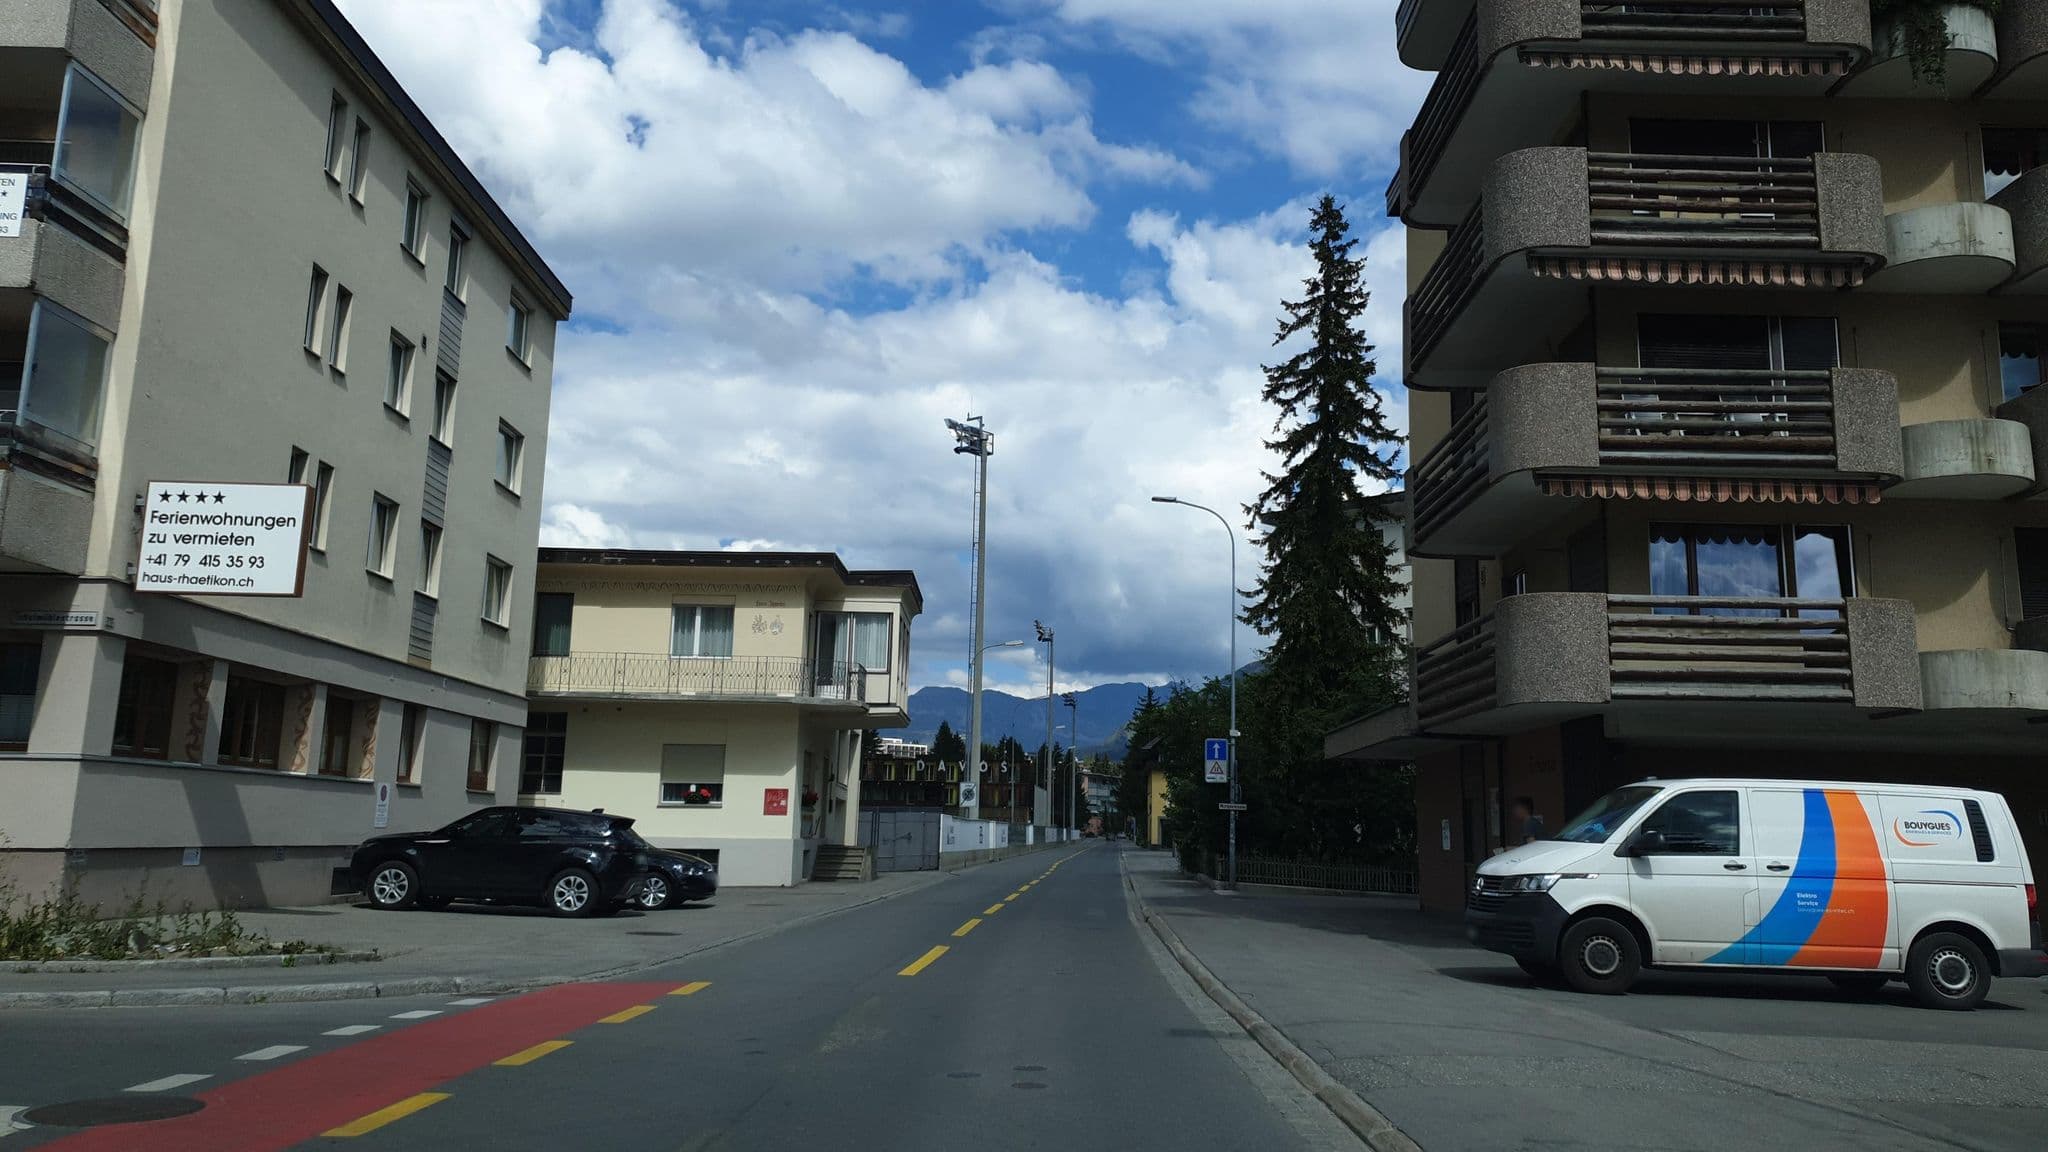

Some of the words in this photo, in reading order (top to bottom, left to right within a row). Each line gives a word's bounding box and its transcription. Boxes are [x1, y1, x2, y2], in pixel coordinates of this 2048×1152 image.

[150, 510, 296, 531] Ferienwohnungen
[147, 533, 167, 544] zu
[173, 532, 255, 547] vermieten
[145, 554, 167, 567] +41
[173, 554, 191, 567] 79
[198, 554, 221, 568] 415
[226, 555, 244, 568] 35
[248, 556, 265, 569] 93
[142, 572, 254, 588] haus-rhaetikon.ch
[917, 759, 1008, 773] DAVOS
[1904, 821, 1951, 831] BOUYGUES
